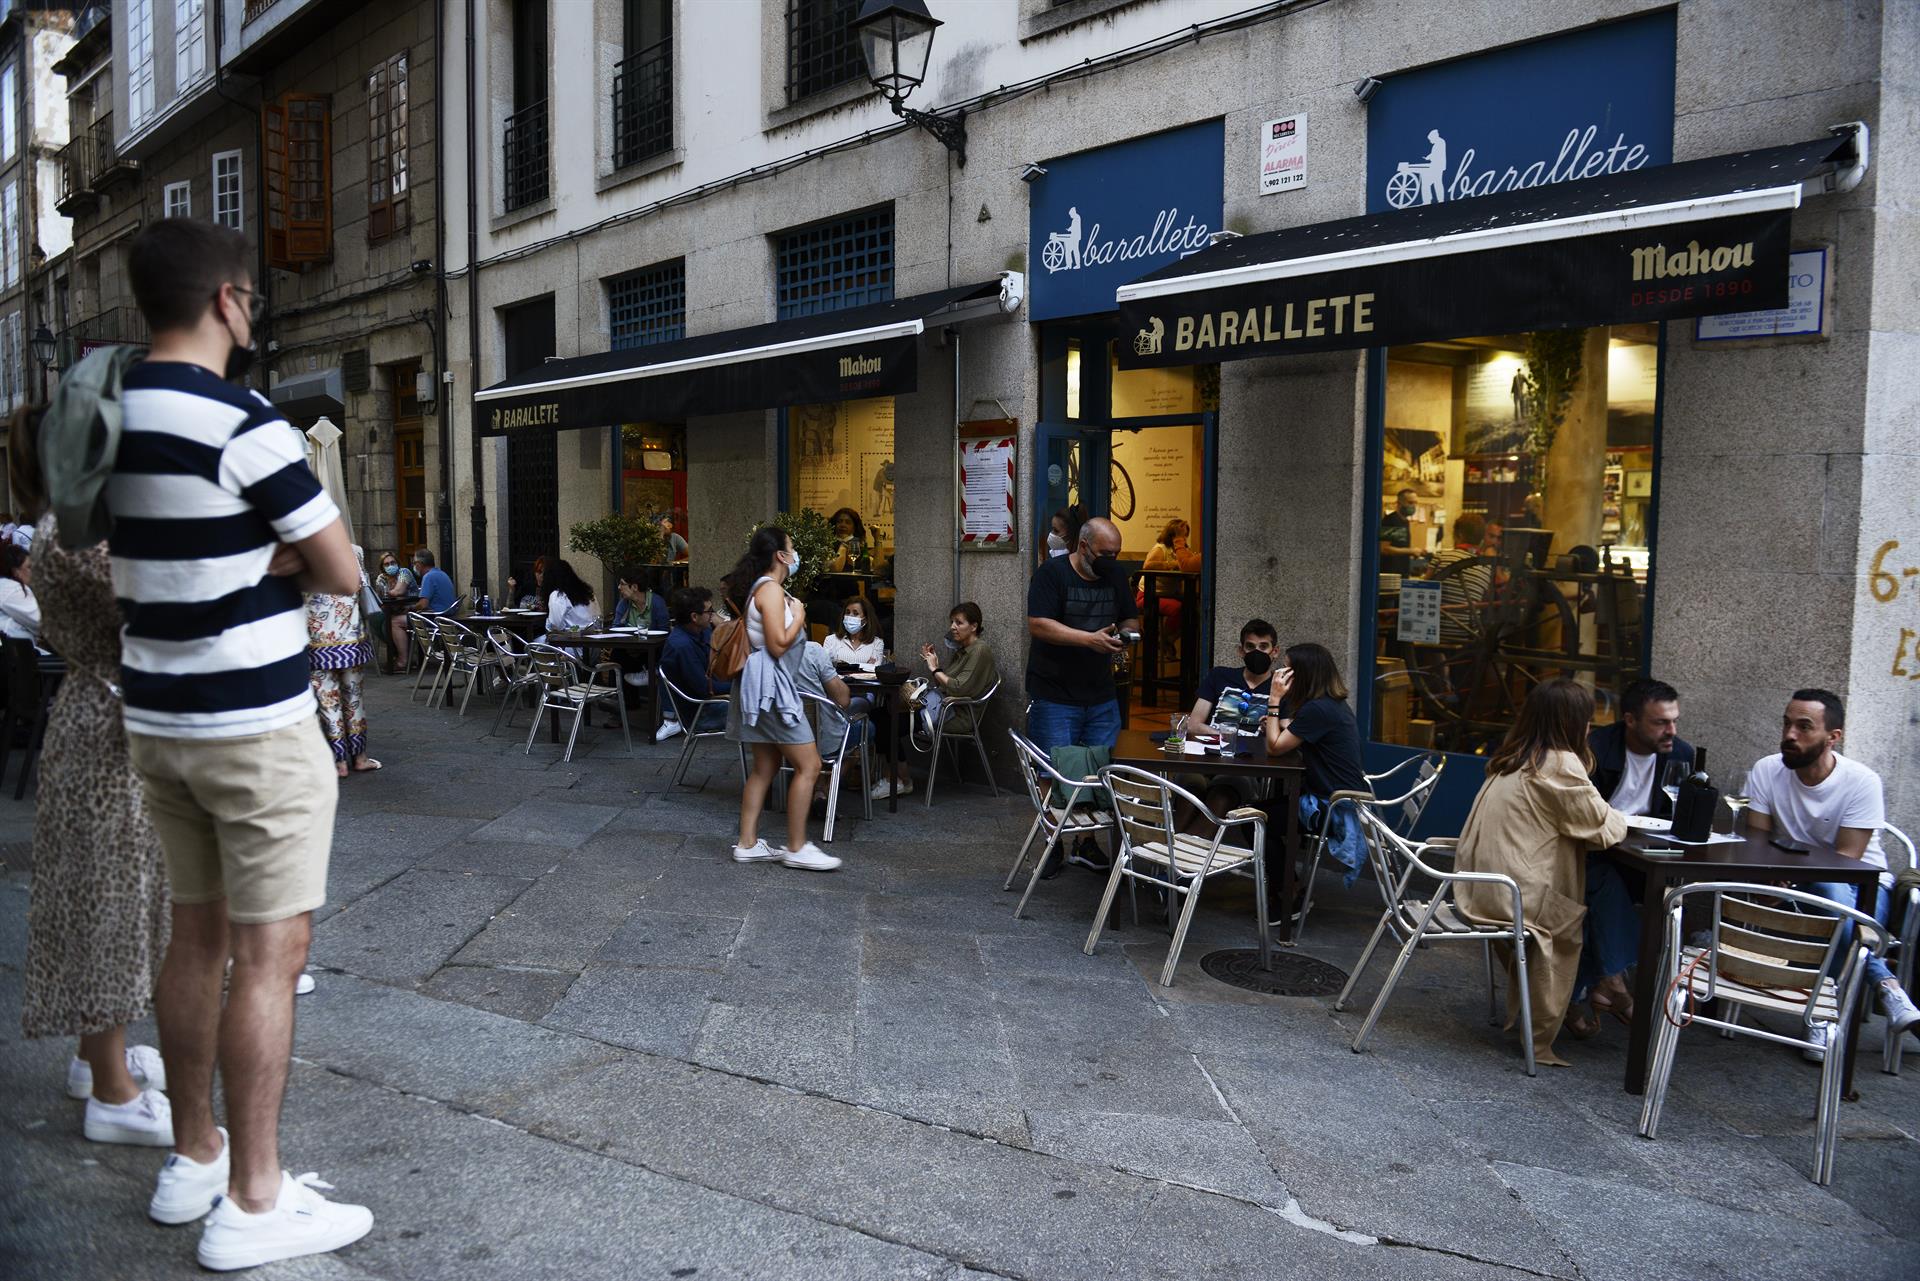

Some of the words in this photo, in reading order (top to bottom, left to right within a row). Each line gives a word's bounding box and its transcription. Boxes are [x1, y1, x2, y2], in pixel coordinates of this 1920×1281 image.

[1264, 155, 1303, 172] ALARMA
[1448, 124, 1649, 200] barallete
[1269, 178, 1280, 187] 902
[1281, 176, 1291, 185] 121
[1293, 173, 1304, 182] 122
[1083, 207, 1210, 267] barallete
[1631, 240, 1755, 281] Mahou
[1632, 287, 1695, 307] DESDE
[1704, 279, 1753, 298] 1890
[1175, 293, 1375, 351] BARALLETE
[503, 403, 559, 428] BARALLETE
